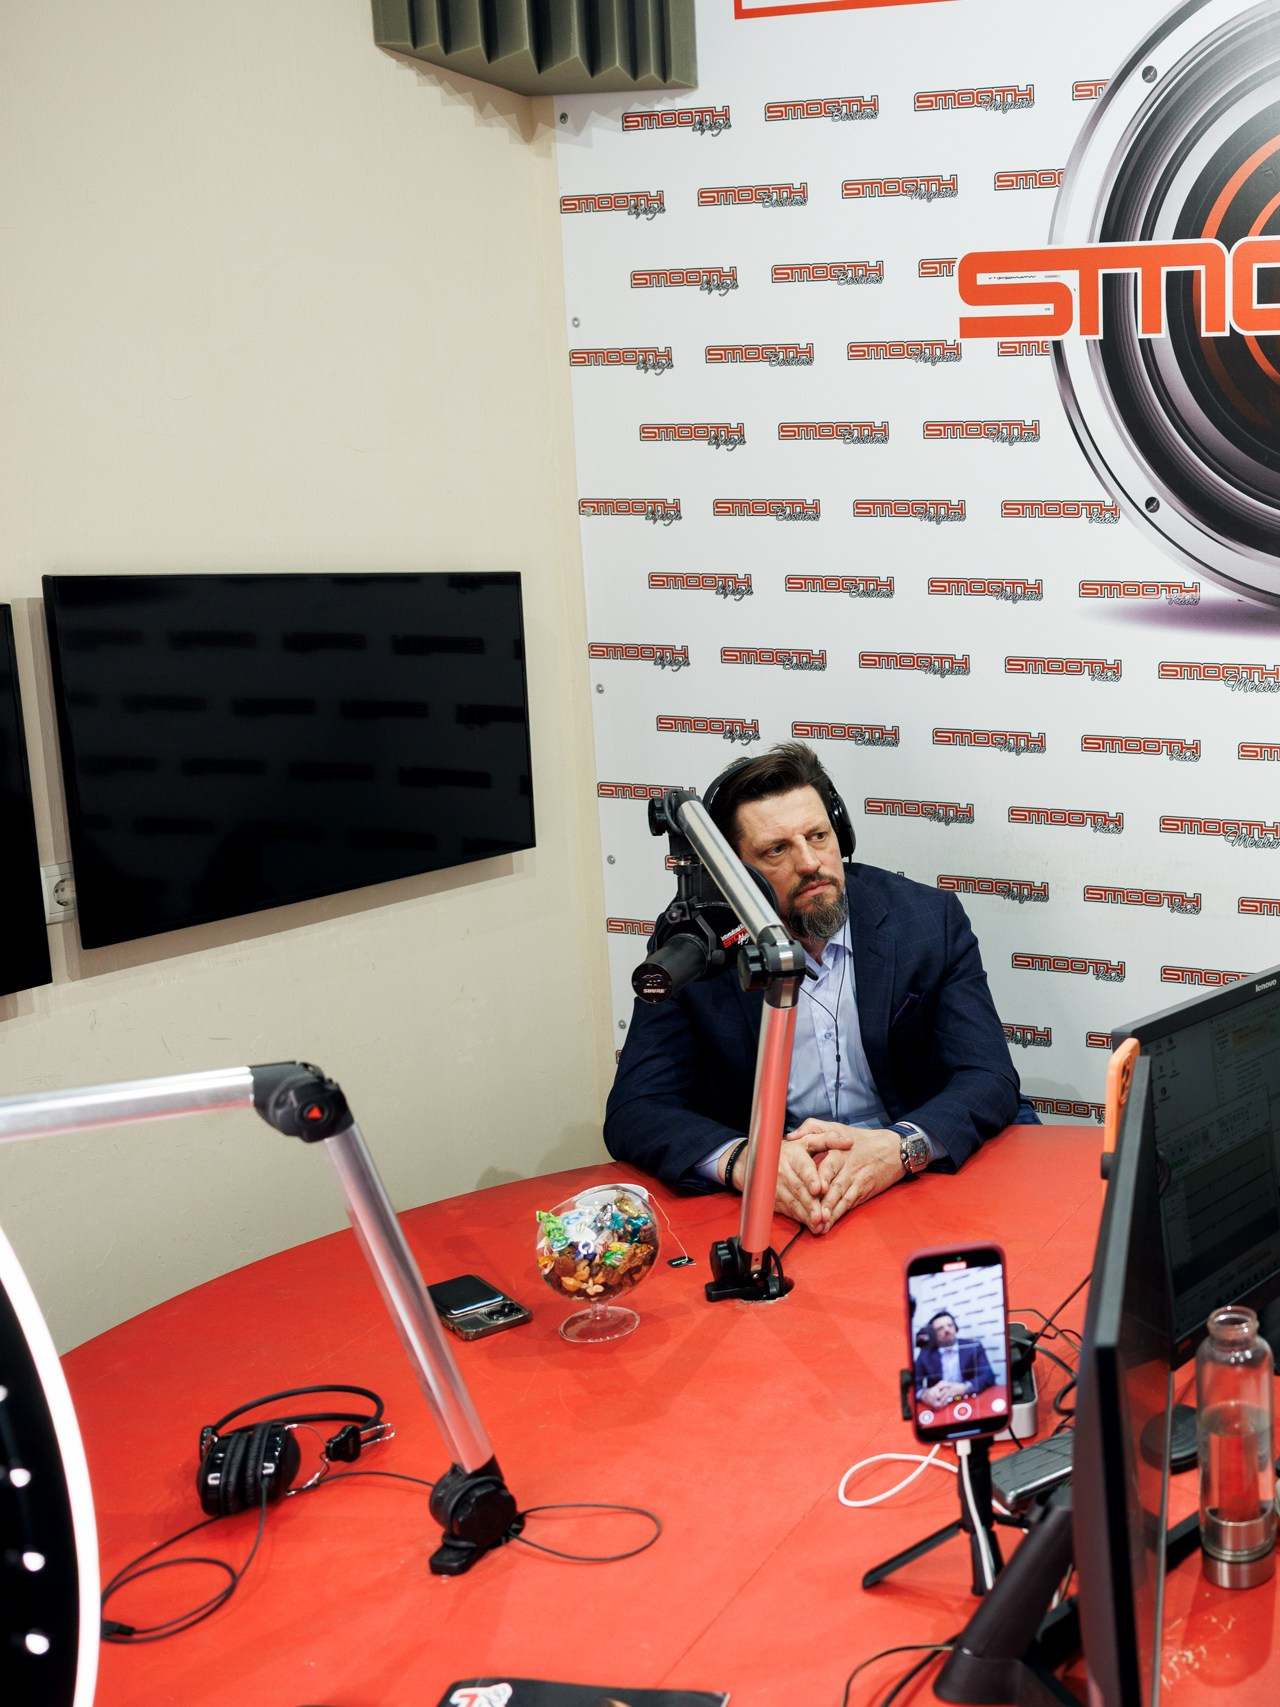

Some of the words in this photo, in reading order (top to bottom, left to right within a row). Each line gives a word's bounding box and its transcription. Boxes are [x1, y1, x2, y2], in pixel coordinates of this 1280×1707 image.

[764, 95, 878, 122] SMOOTH
[914, 84, 1034, 112] SMOOTH
[622, 105, 730, 131] SMOOTH
[697, 182, 807, 207] SMOOTH
[841, 174, 958, 199] SMOOTH
[560, 190, 664, 214] SMOOTH
[630, 266, 737, 288] SMOOTH
[771, 260, 884, 283] SMOOTH
[569, 347, 672, 366] SMOOTH
[705, 343, 814, 363] SMOOTH
[847, 340, 961, 360] SMOOTH
[639, 423, 744, 441] SMOOTH
[778, 421, 889, 440] SMOOTH
[923, 420, 1040, 439] SMOOTH
[713, 499, 820, 516] SMOOTH
[853, 499, 966, 518] SMOOTH
[1001, 500, 1118, 518] SMOOTH
[648, 572, 752, 591] SMOOTH
[785, 575, 894, 593] SMOOTH
[928, 577, 1043, 597] SMOOTH
[1079, 580, 1200, 600] SMOOTH
[588, 642, 688, 662] SMOOTH
[720, 647, 826, 667] SMOOTH
[859, 651, 970, 672] SMOOTH
[1004, 656, 1122, 677] SMOOTH
[1223, 673, 1280, 692] Media
[656, 715, 759, 736] SMOOTH
[791, 721, 899, 743] SMOOTH
[932, 727, 1046, 750] SMOOTH
[1081, 734, 1201, 757] SMOOTH
[864, 797, 974, 821] SMOOTH
[1008, 806, 1124, 829] SMOOTH
[1159, 815, 1280, 840] SMOOTH
[1223, 829, 1280, 849] Media
[937, 874, 1049, 899] SMOOTH
[1083, 885, 1201, 910] SMOOTH
[1011, 952, 1125, 978] SMOOTH
